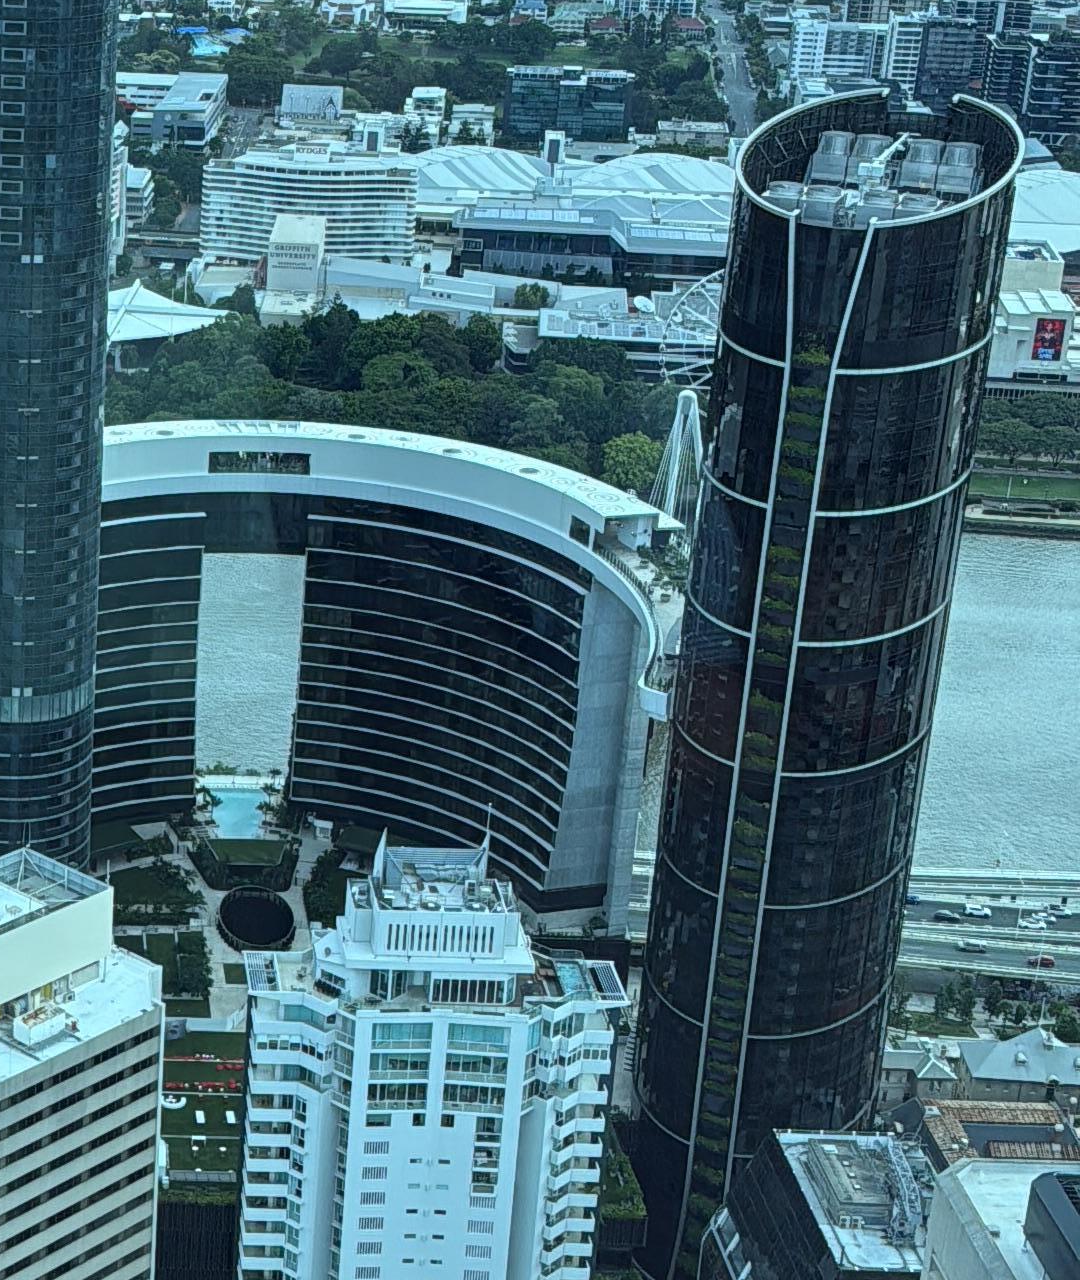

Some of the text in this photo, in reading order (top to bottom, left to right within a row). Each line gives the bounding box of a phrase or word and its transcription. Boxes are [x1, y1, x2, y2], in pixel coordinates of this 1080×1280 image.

[295, 146, 328, 155] RYDGES
[274, 244, 312, 252] GRIFFITH
[270, 252, 317, 260] UNIVERSITY
